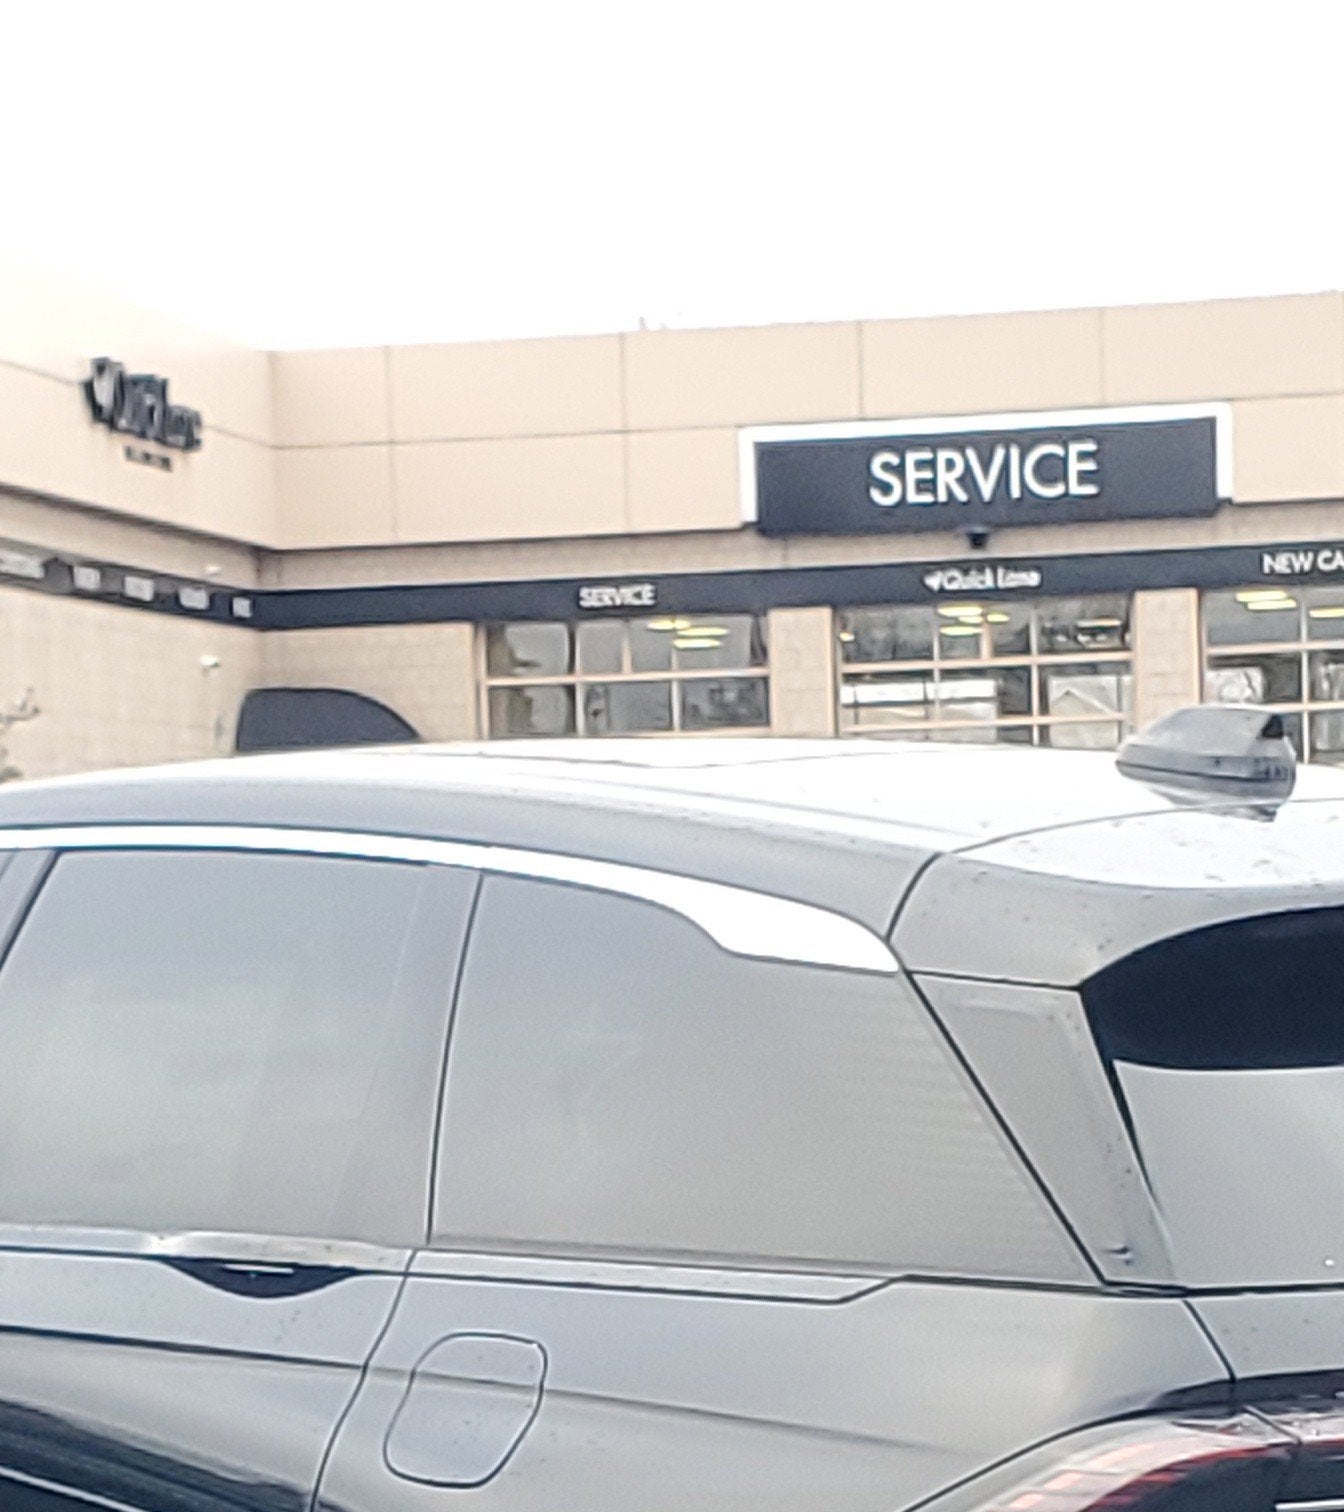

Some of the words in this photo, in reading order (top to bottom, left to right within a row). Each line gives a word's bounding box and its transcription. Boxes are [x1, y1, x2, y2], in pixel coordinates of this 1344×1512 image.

[868, 439, 1100, 508] SERVICE
[1262, 551, 1314, 575] NEW
[942, 566, 995, 591] Quick
[579, 584, 656, 608] SERVICE
